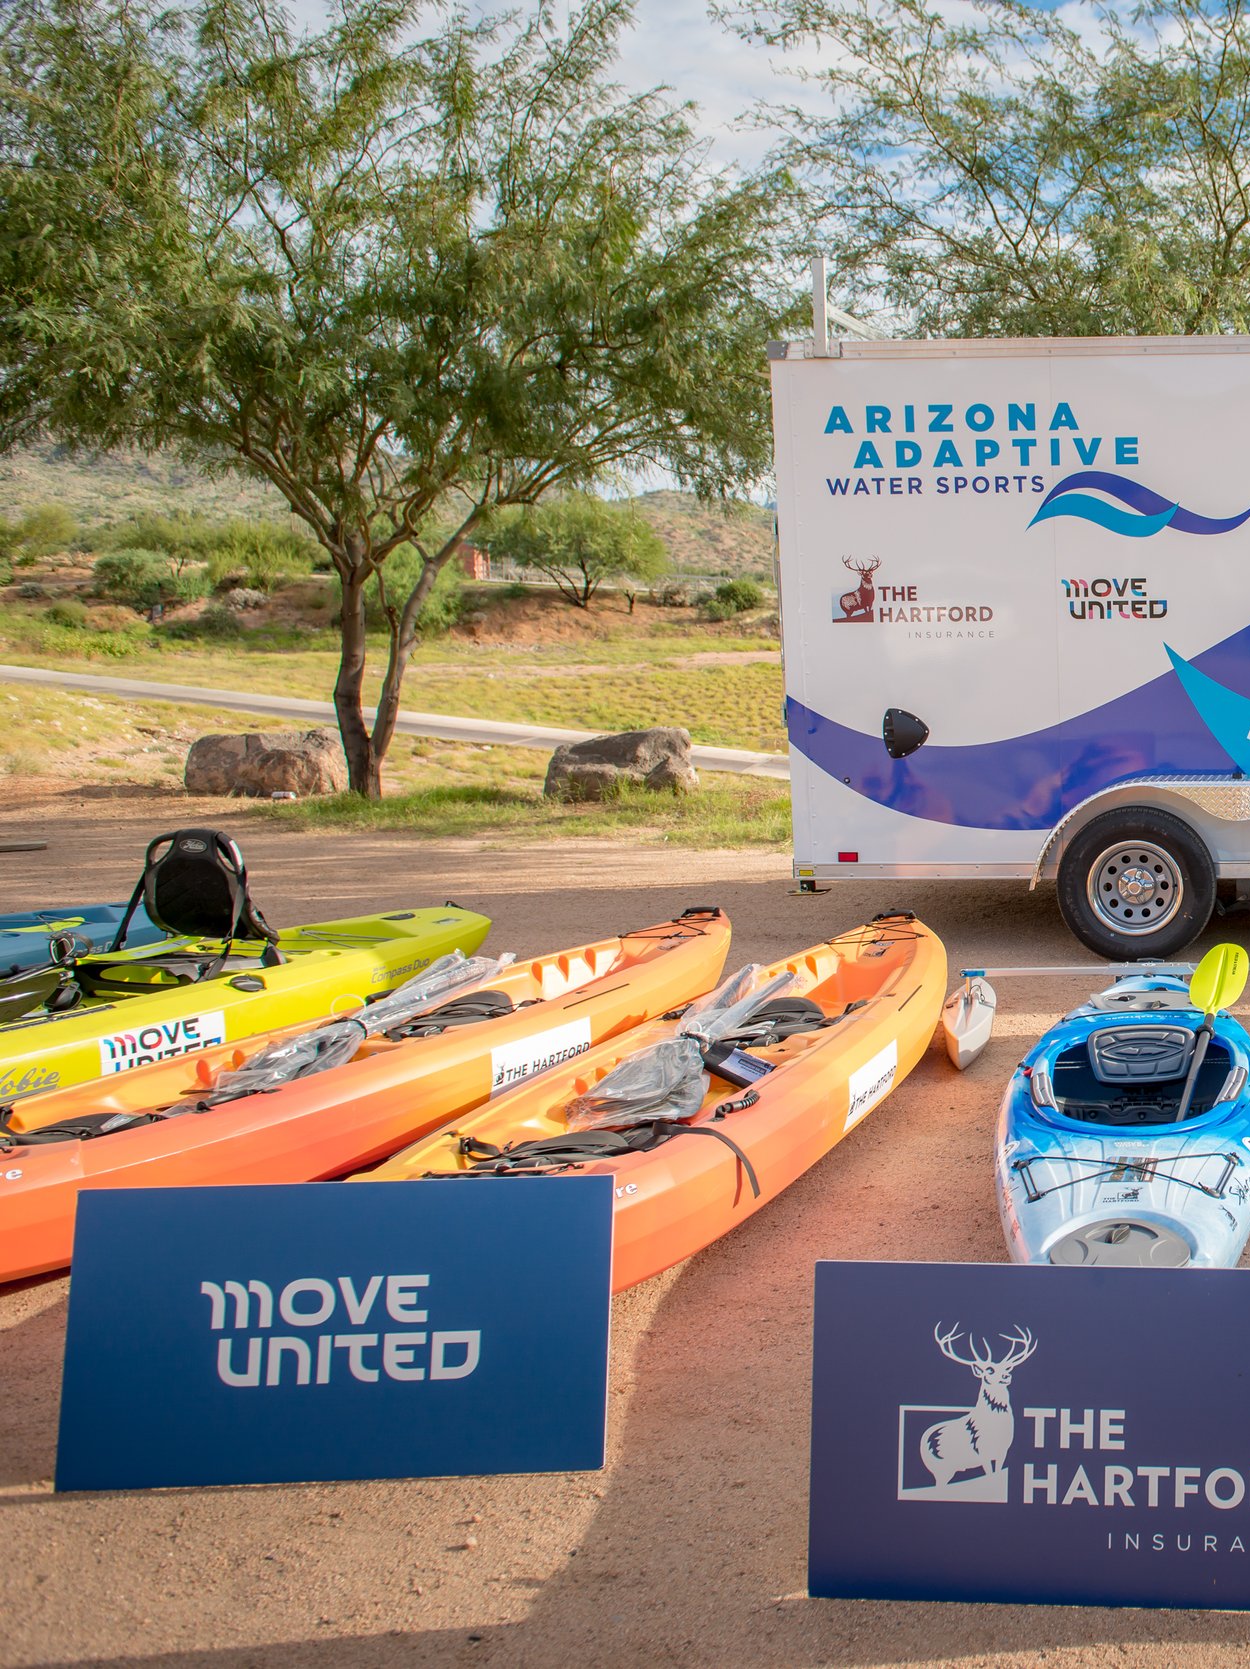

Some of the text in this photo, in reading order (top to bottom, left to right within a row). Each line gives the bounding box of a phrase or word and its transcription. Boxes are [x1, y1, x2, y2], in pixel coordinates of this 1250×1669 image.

[824, 402, 1079, 434] ARIZONA
[853, 437, 1139, 469] ADAPTIVE
[826, 475, 1045, 496] WATER SPORTS
[878, 586, 918, 602] THE
[1061, 578, 1147, 598] MOVE
[879, 606, 993, 623] HARTFORD
[1070, 600, 1168, 619] UNITED
[908, 630, 995, 639] INSURANCE
[371, 957, 431, 984] Compass Duo
[103, 1018, 199, 1059] MOVE
[506, 1042, 590, 1082] THE HARTFORD
[0, 1067, 60, 1096] obie
[200, 1274, 430, 1329] MOVE
[217, 1330, 481, 1387] UNITED
[1023, 1407, 1126, 1450] THE
